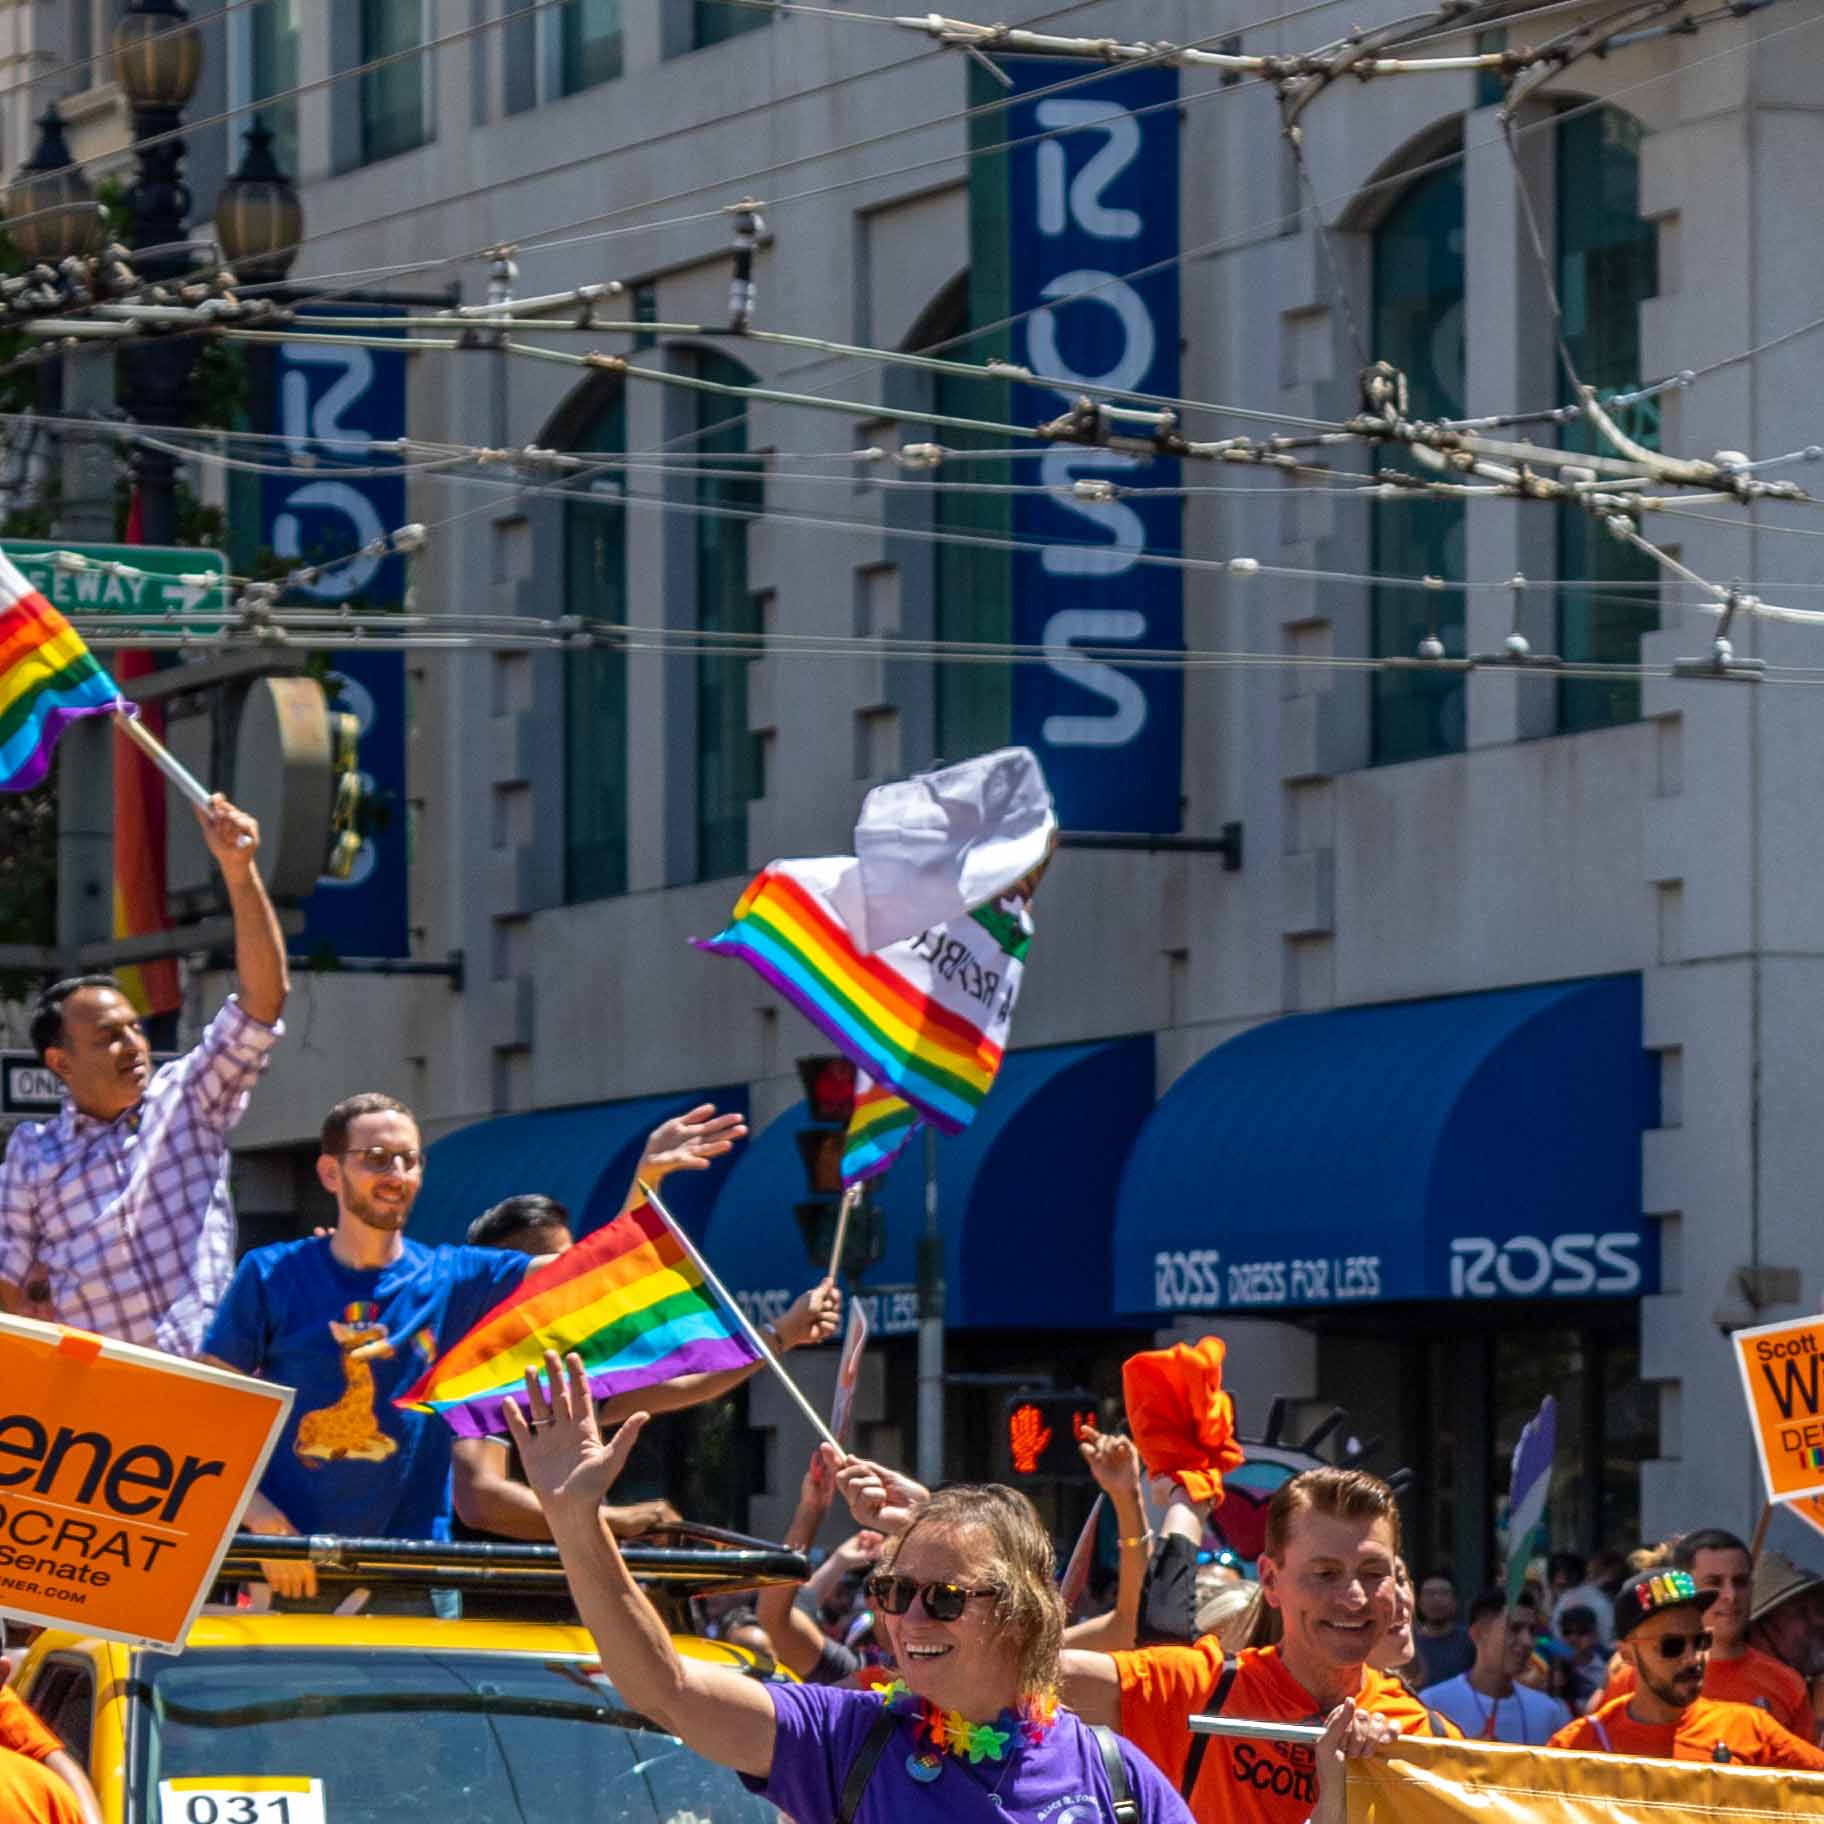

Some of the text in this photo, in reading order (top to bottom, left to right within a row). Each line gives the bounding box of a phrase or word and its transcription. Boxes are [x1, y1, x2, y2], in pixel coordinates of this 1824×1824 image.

[1027, 97, 1156, 748] ROSS
[1155, 1249, 1381, 1307] ROSS DRESS FOR LESS
[1450, 1232, 1640, 1297] ROSS
[1756, 1333, 1818, 1361] Scott
